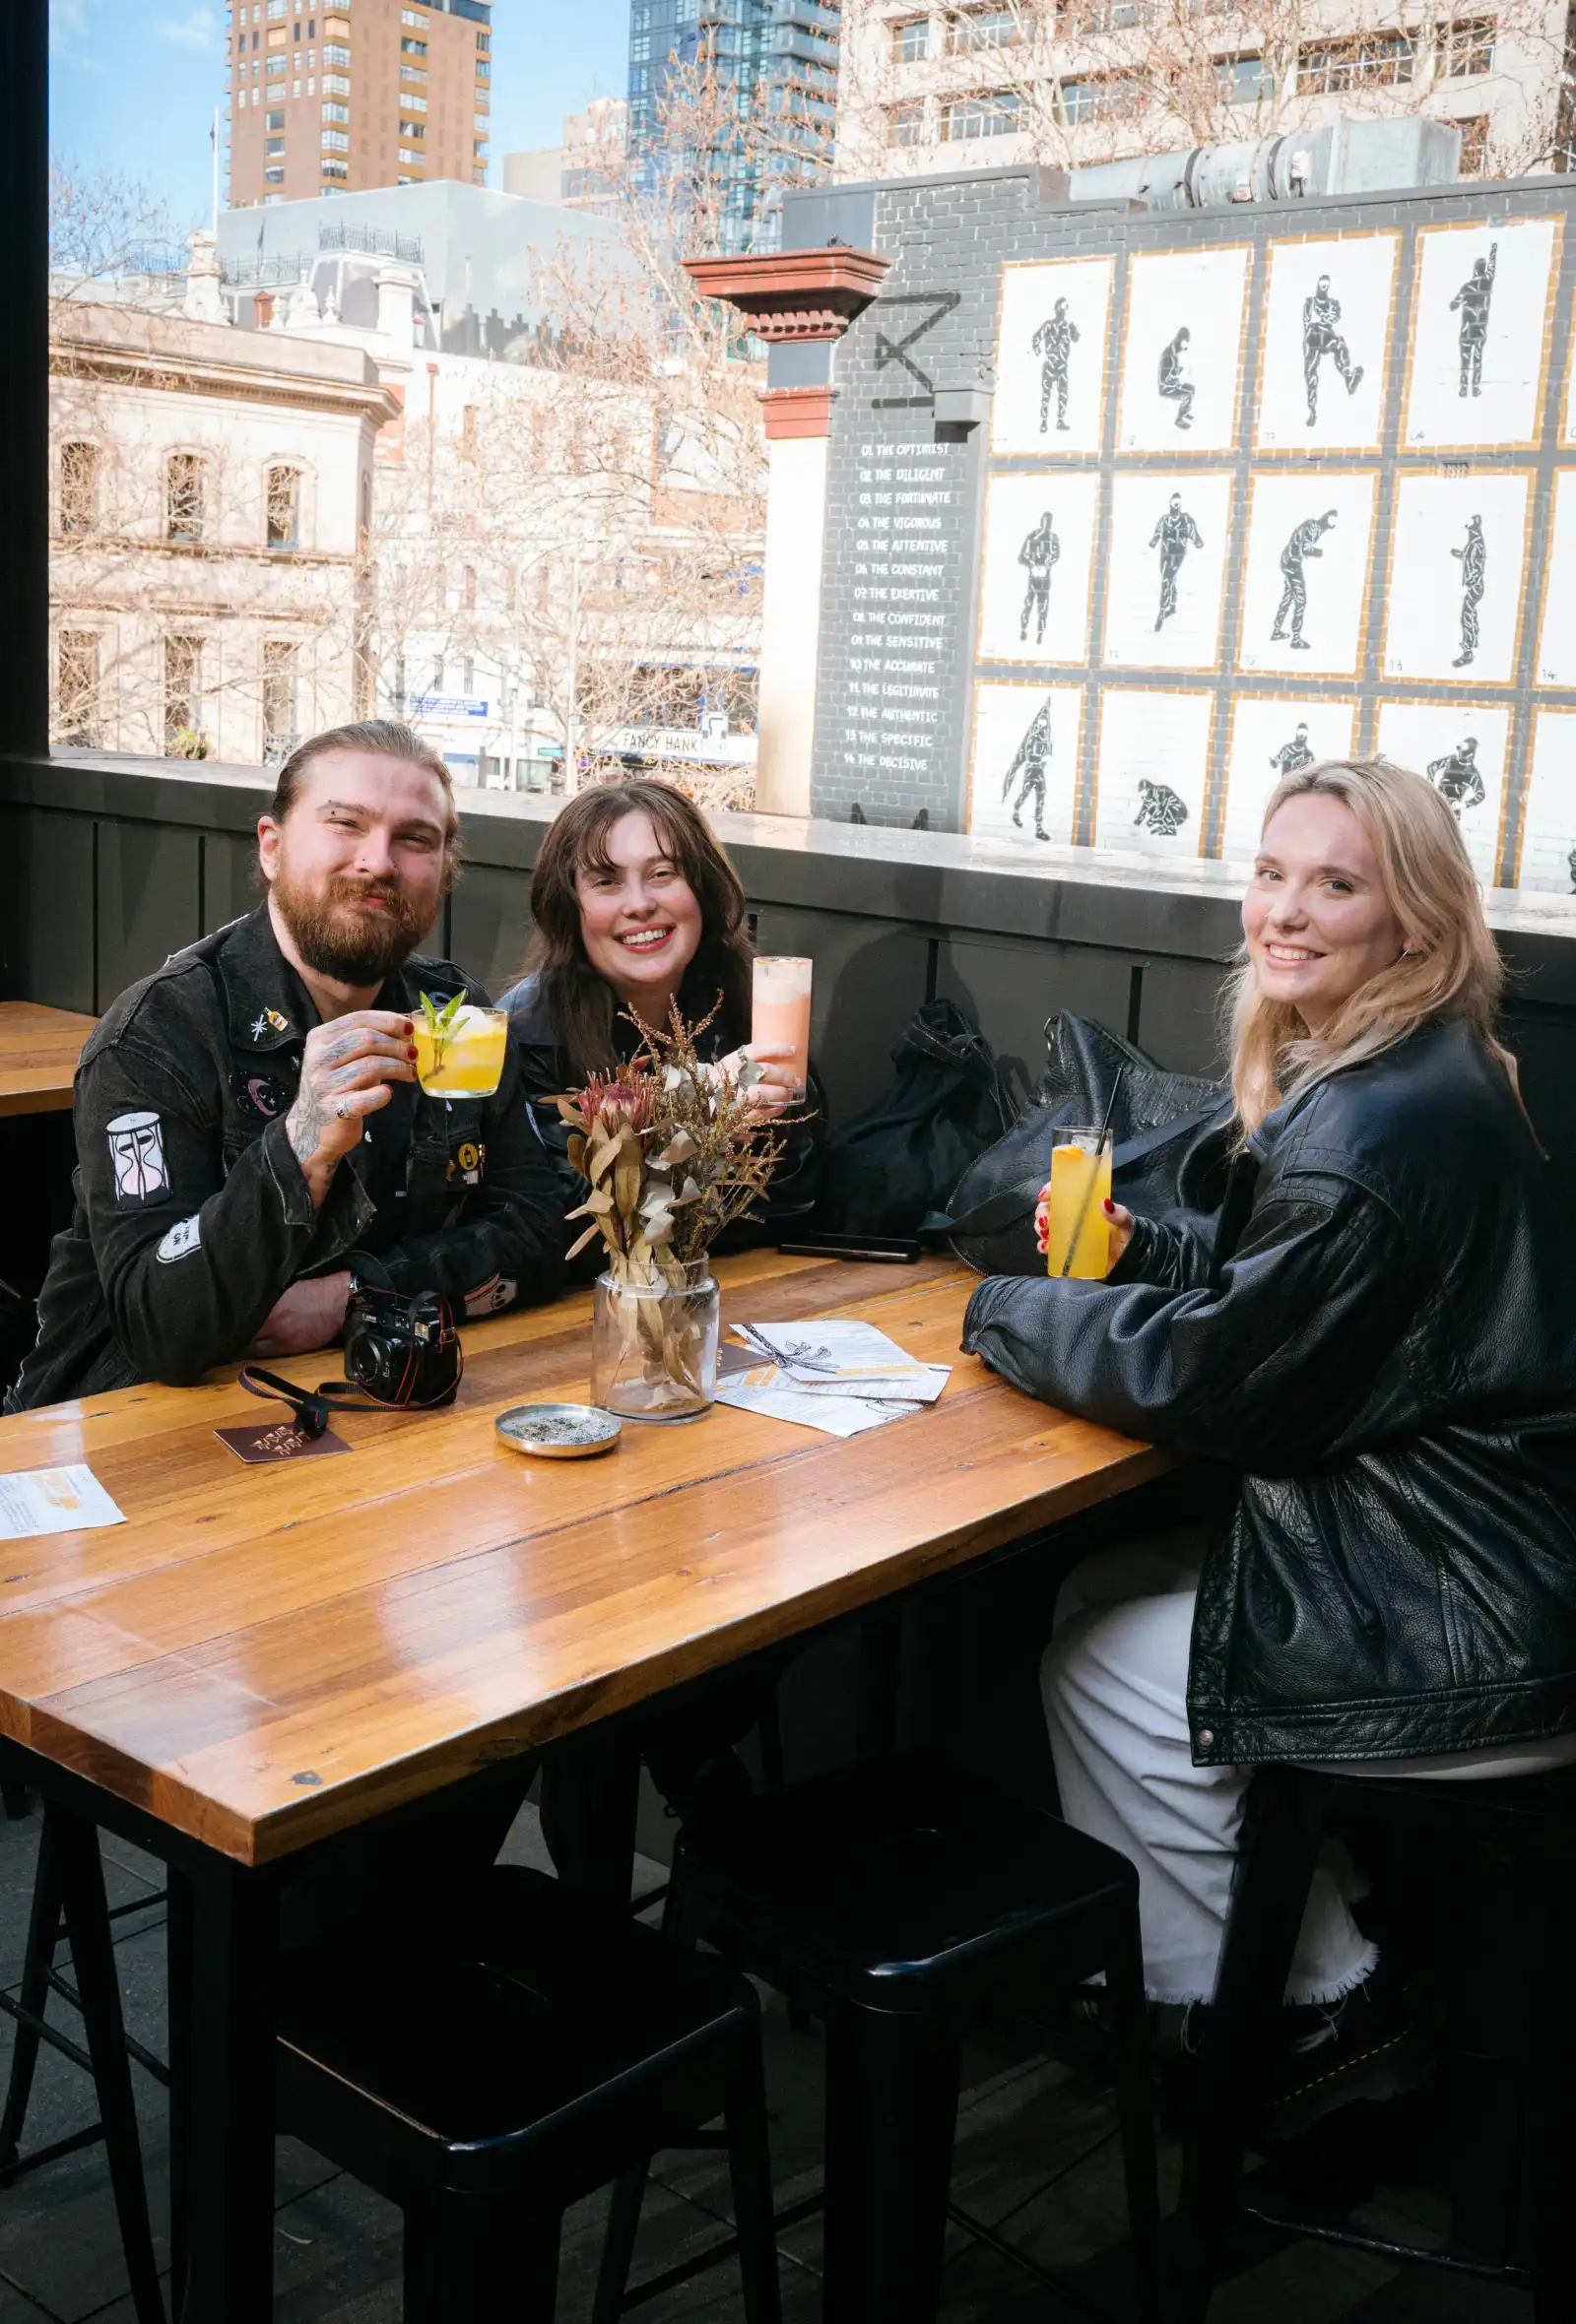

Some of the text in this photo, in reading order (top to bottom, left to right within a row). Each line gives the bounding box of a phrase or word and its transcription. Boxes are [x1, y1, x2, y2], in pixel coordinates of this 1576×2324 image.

[877, 444, 894, 455] THE
[896, 443, 950, 455] OPTIMIST
[875, 469, 892, 481] THE
[896, 468, 946, 483] DILIGENT
[875, 492, 892, 504] THE
[895, 491, 952, 504] FORTUNATE
[872, 517, 890, 529] THE
[893, 517, 942, 529] VIGOROUS
[872, 540, 888, 550] THE
[891, 540, 949, 551] ATTENTIVE
[871, 563, 888, 575] THE
[891, 563, 945, 577] CONSTANT
[869, 587, 888, 599] THE
[868, 612, 886, 624] THE
[887, 613, 946, 626] CONFIDENT
[865, 635, 884, 646] THE
[886, 635, 944, 650] SENSITIVE
[863, 658, 882, 671] THE
[885, 659, 936, 674] ACCURATE
[862, 682, 880, 694] THE
[882, 682, 940, 698] LEGITIMATE
[860, 707, 878, 719] THE
[882, 708, 938, 723] AUTHENTIC
[623, 732, 661, 750] FANCY
[858, 731, 878, 743] THE
[882, 733, 934, 747] SPECIFIC
[858, 753, 876, 766] THE
[879, 756, 927, 770] DECISIVE
